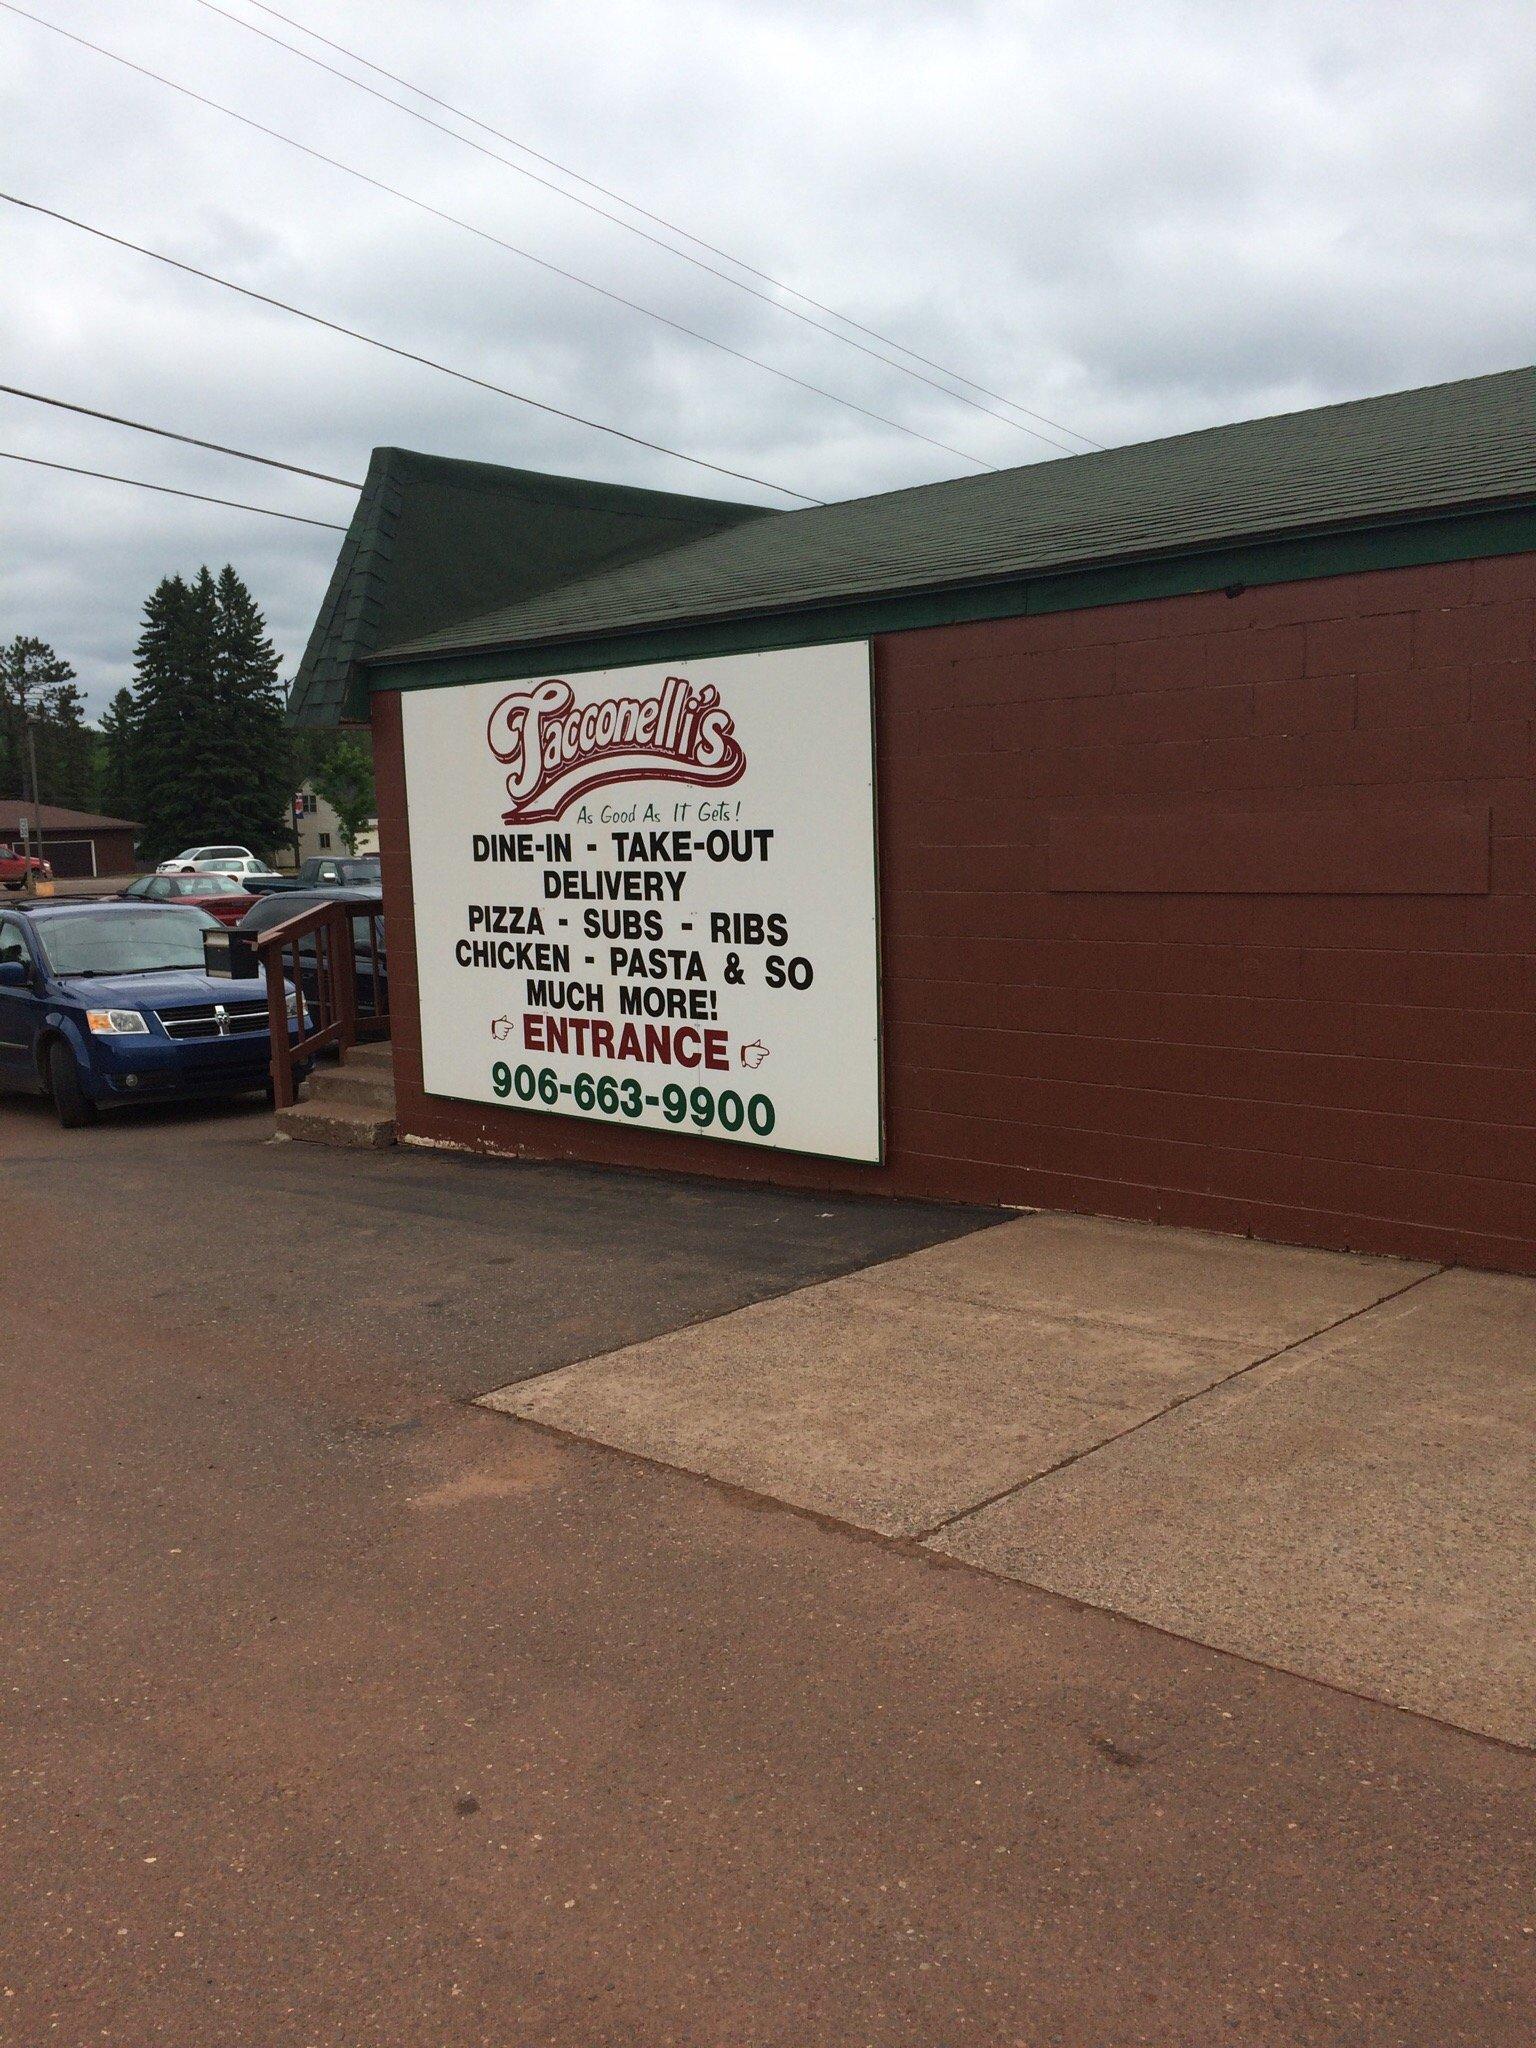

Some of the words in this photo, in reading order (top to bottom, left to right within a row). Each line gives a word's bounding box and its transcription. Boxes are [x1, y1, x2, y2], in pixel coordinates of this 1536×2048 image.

[488, 677, 740, 804] Tacconelli's
[577, 806, 593, 824] As
[601, 804, 636, 823] Good
[643, 804, 660, 822] As
[473, 833, 572, 862] DINE-IN
[612, 829, 774, 862] TAKE-OUT
[543, 871, 686, 901] DELIVERY
[469, 905, 545, 935] PIZZA
[584, 908, 663, 941] SUBS
[711, 912, 788, 947] RIBS
[456, 939, 570, 973] CHICKEN
[610, 947, 707, 981] PASTA
[724, 952, 745, 985] &
[765, 955, 813, 990] SO
[527, 979, 604, 1012] MUCH
[619, 986, 717, 1020] MORE!
[523, 1012, 729, 1071] ENTRANCE
[492, 1062, 775, 1136] 906-663-9900
